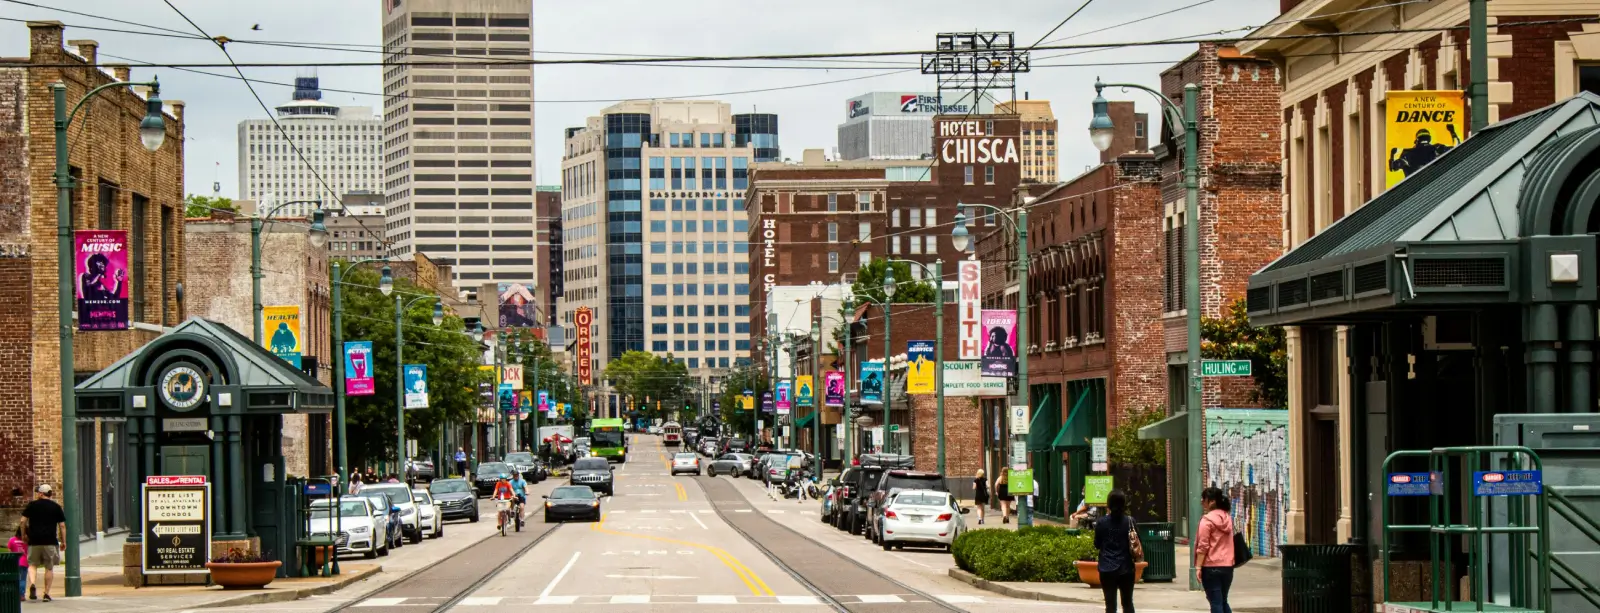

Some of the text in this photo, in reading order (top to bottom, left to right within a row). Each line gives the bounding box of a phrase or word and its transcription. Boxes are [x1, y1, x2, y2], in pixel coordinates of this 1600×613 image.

[918, 105, 968, 113] TENNESSEE
[1395, 111, 1455, 122] DANCE
[940, 121, 984, 136] HOTEL
[942, 138, 1019, 163] CHISCA
[81, 243, 122, 252] MUSIC
[763, 219, 776, 267] HOTEL
[961, 263, 979, 357] SMITH
[943, 361, 973, 370] ISCOUNT
[1204, 363, 1236, 374] HULING
